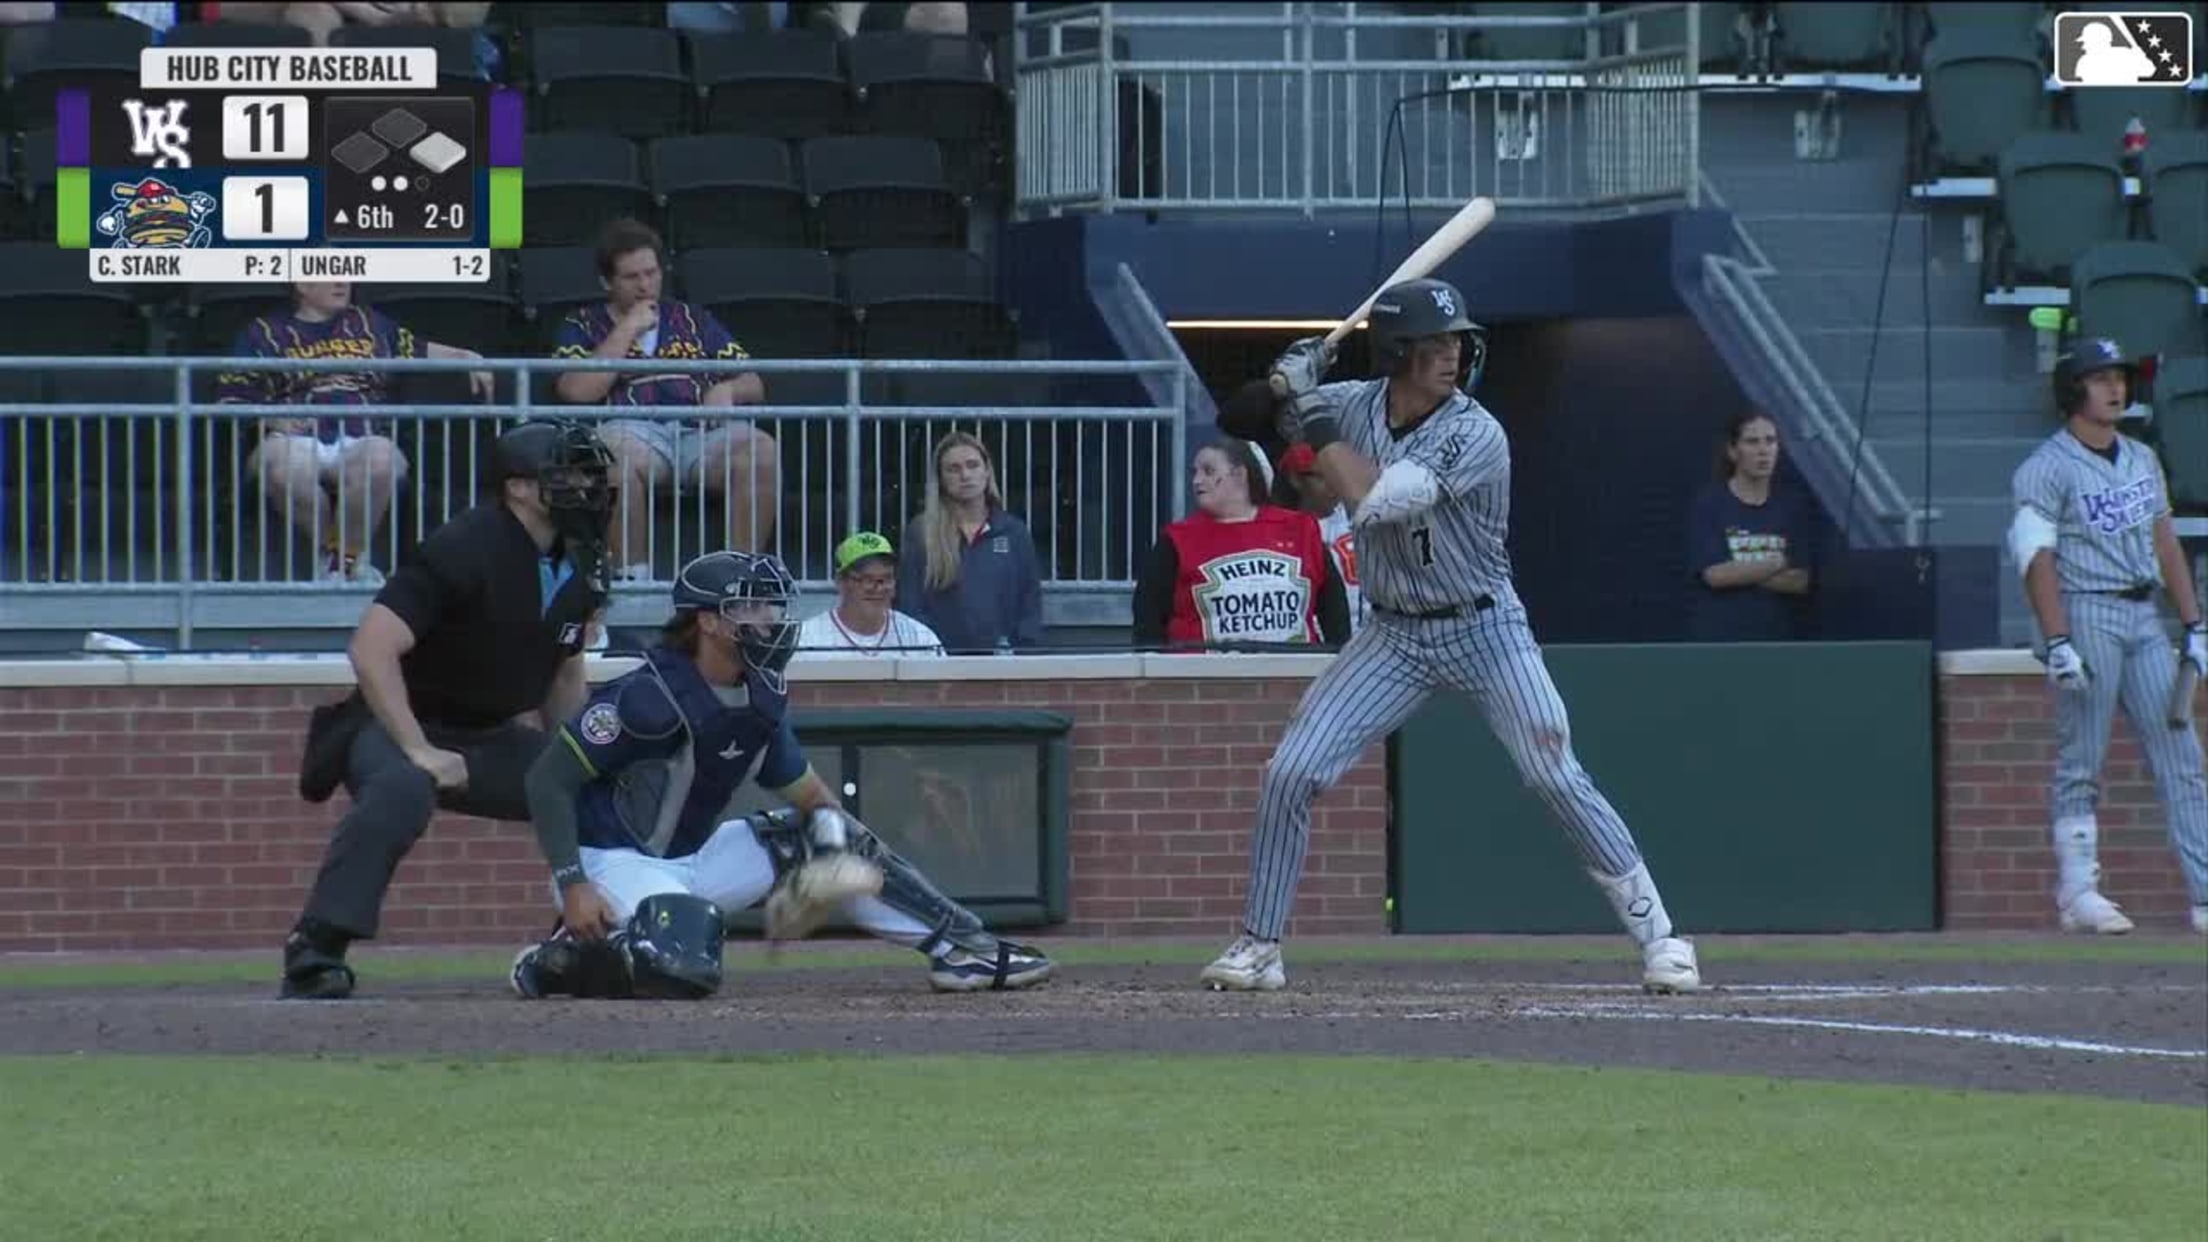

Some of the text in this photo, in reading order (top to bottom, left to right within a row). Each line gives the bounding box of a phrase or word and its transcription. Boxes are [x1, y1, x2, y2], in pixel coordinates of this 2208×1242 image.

[1412, 527, 1434, 566] 7
[1220, 559, 1286, 581] HEINZ
[1211, 590, 1300, 617] TOMATO
[1219, 612, 1299, 634] KETCHUP
